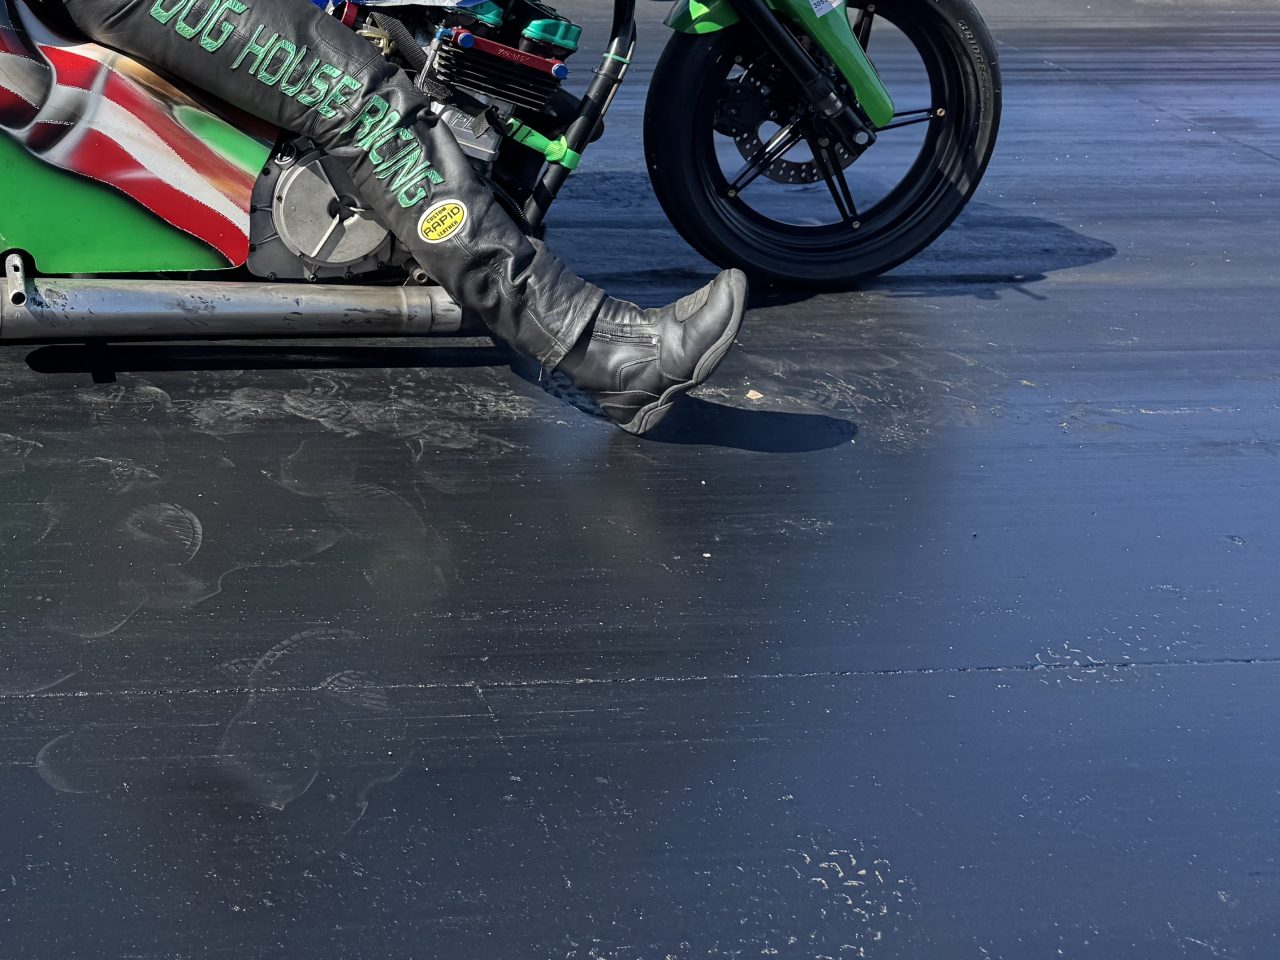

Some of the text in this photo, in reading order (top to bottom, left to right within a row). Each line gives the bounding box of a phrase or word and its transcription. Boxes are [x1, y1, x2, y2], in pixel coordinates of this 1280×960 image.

[229, 24, 363, 120] HOUSE
[341, 94, 446, 209] RACING
[423, 206, 461, 237] RAPID
[426, 207, 447, 224] CUSTOM
[437, 221, 459, 238] LEATHER
